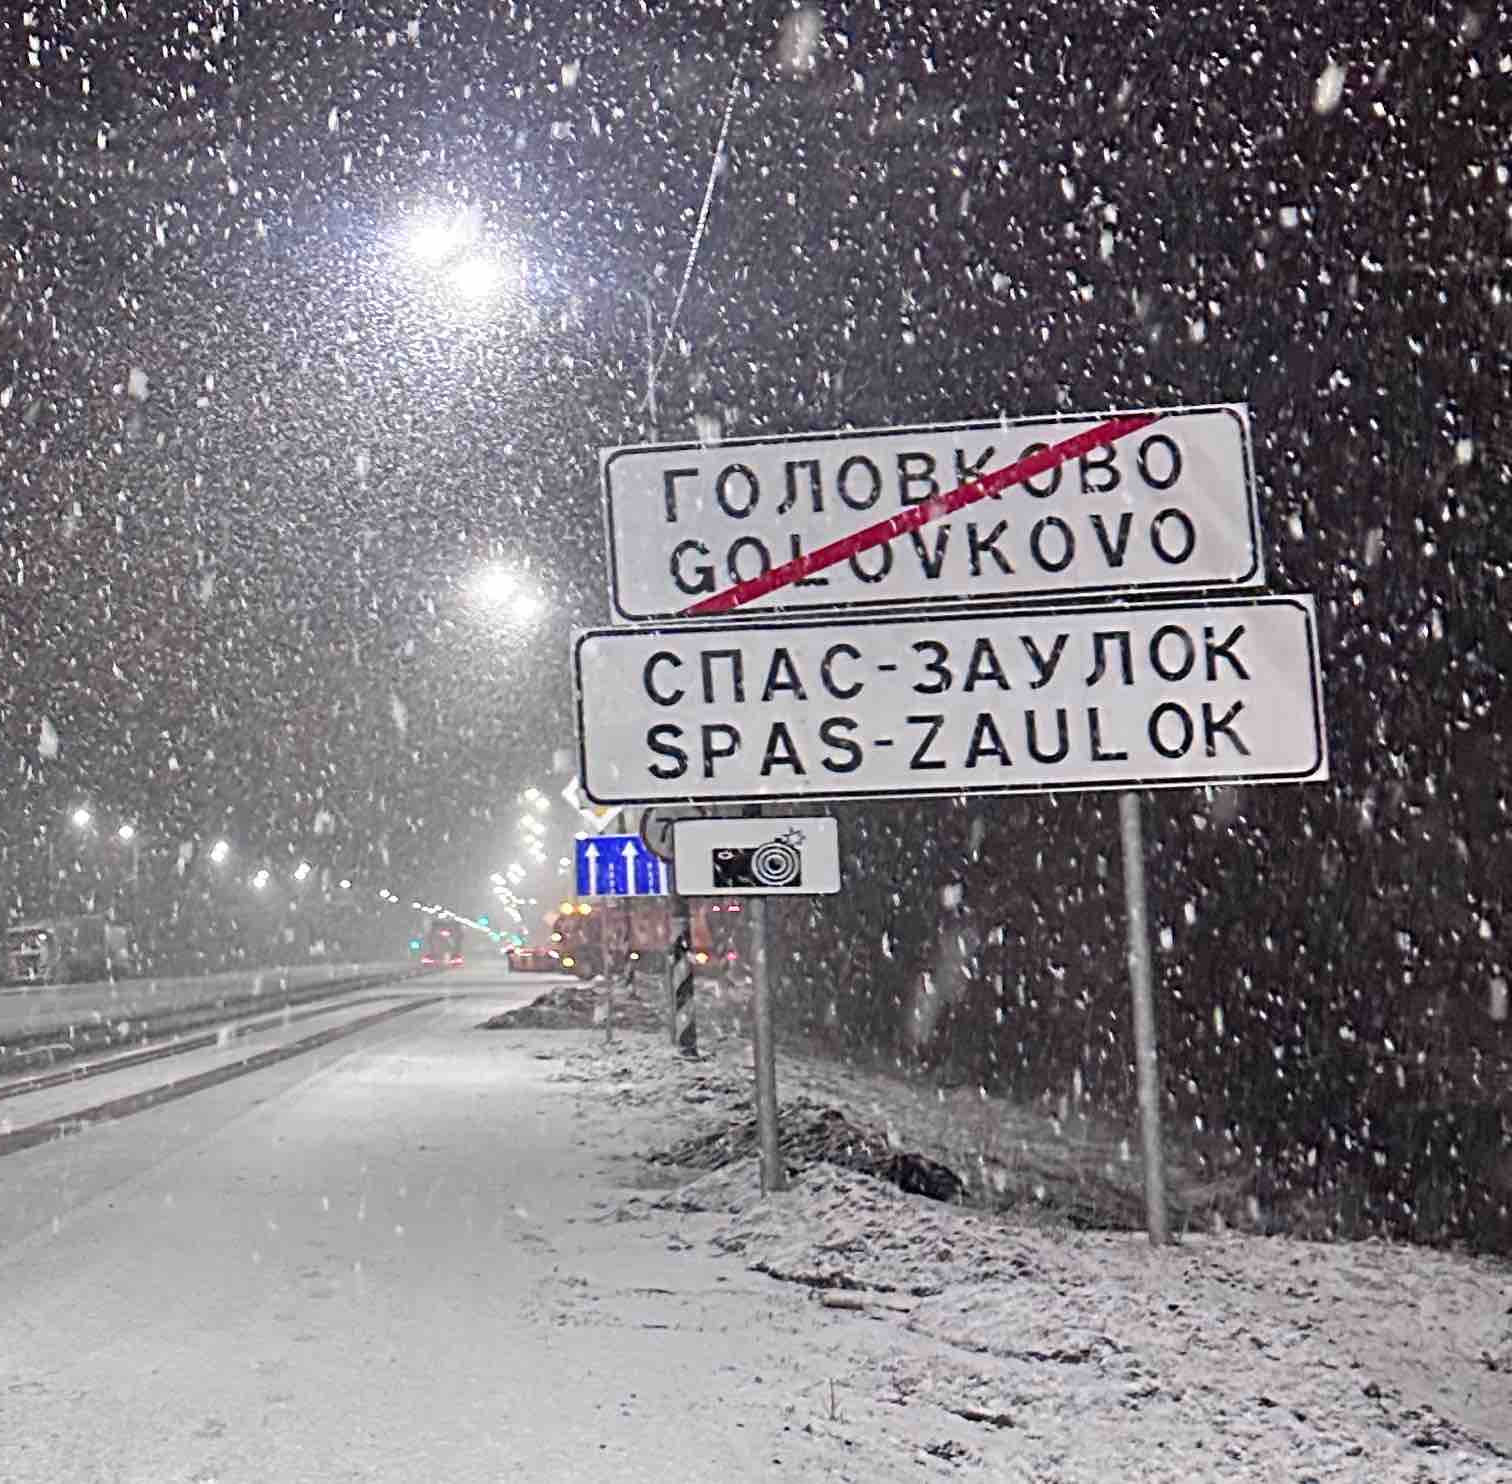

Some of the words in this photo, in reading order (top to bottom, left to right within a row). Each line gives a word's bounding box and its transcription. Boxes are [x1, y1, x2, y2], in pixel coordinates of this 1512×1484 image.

[663, 433, 1183, 523] ГОЛОВКОВО
[670, 508, 1196, 594] GOLOVKOVO
[643, 624, 1251, 706] СПАС-ЗАУЛОК
[646, 701, 1251, 780] SPAS-ZAULOK
